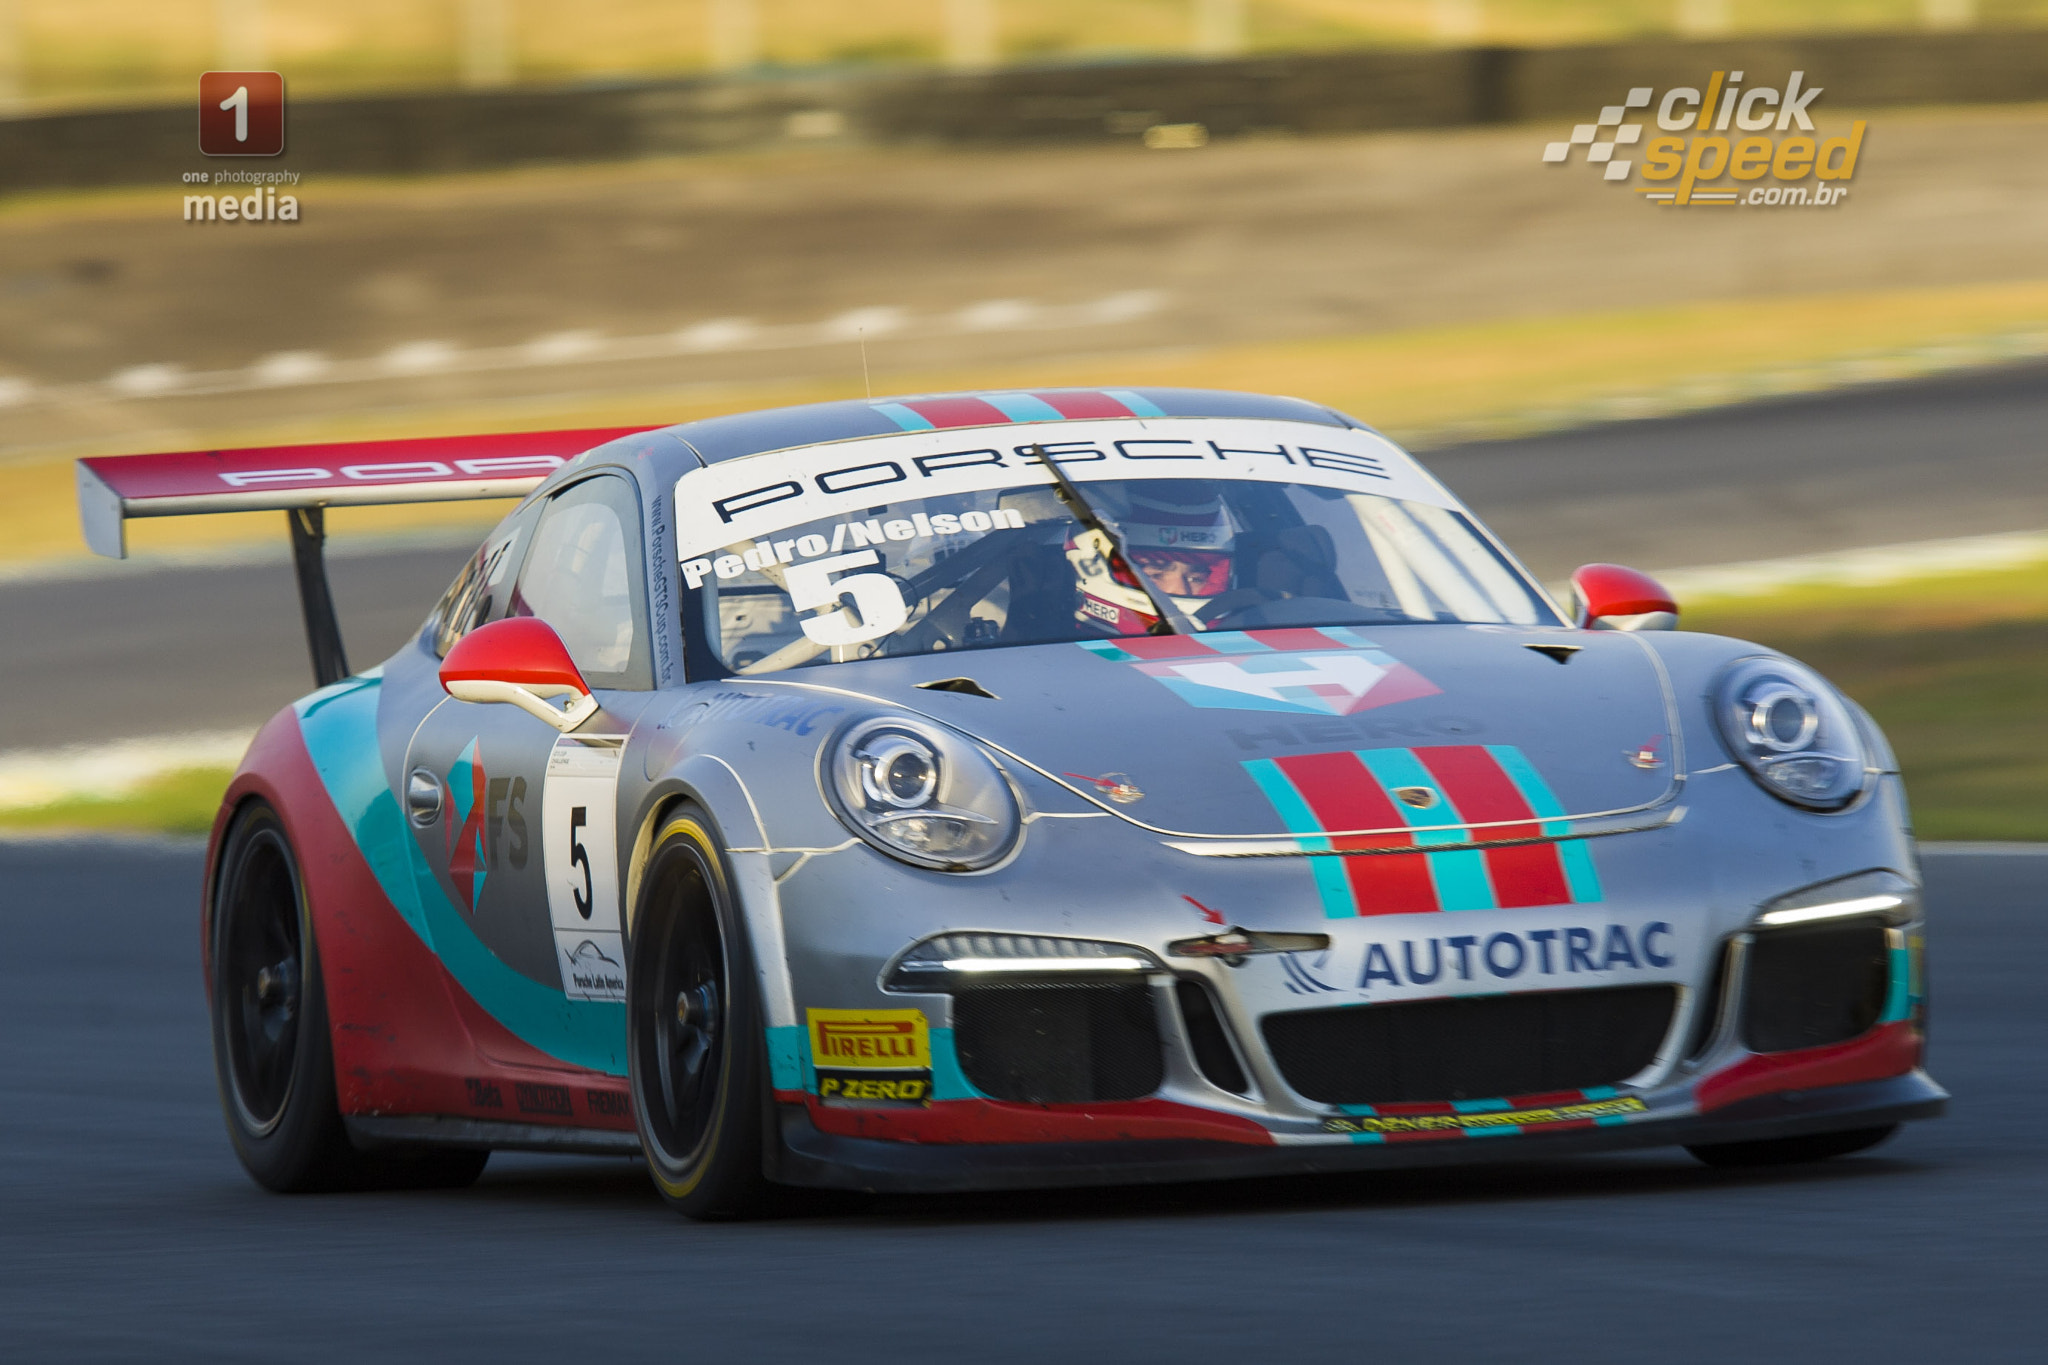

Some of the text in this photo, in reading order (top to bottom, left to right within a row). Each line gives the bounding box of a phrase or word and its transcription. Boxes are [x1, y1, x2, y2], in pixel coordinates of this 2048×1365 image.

[711, 437, 1392, 525] PORSCHE
[681, 507, 1026, 590] Pedro/Nelson
[783, 549, 908, 646] 5
[1085, 600, 1117, 621] HERO
[1224, 715, 1487, 751] HERO
[488, 776, 528, 871] FS
[570, 806, 593, 920] 5
[1356, 921, 1675, 988] AUTOTRAC
[815, 1020, 917, 1057] PIRELLI
[842, 1079, 926, 1100] ZERO
